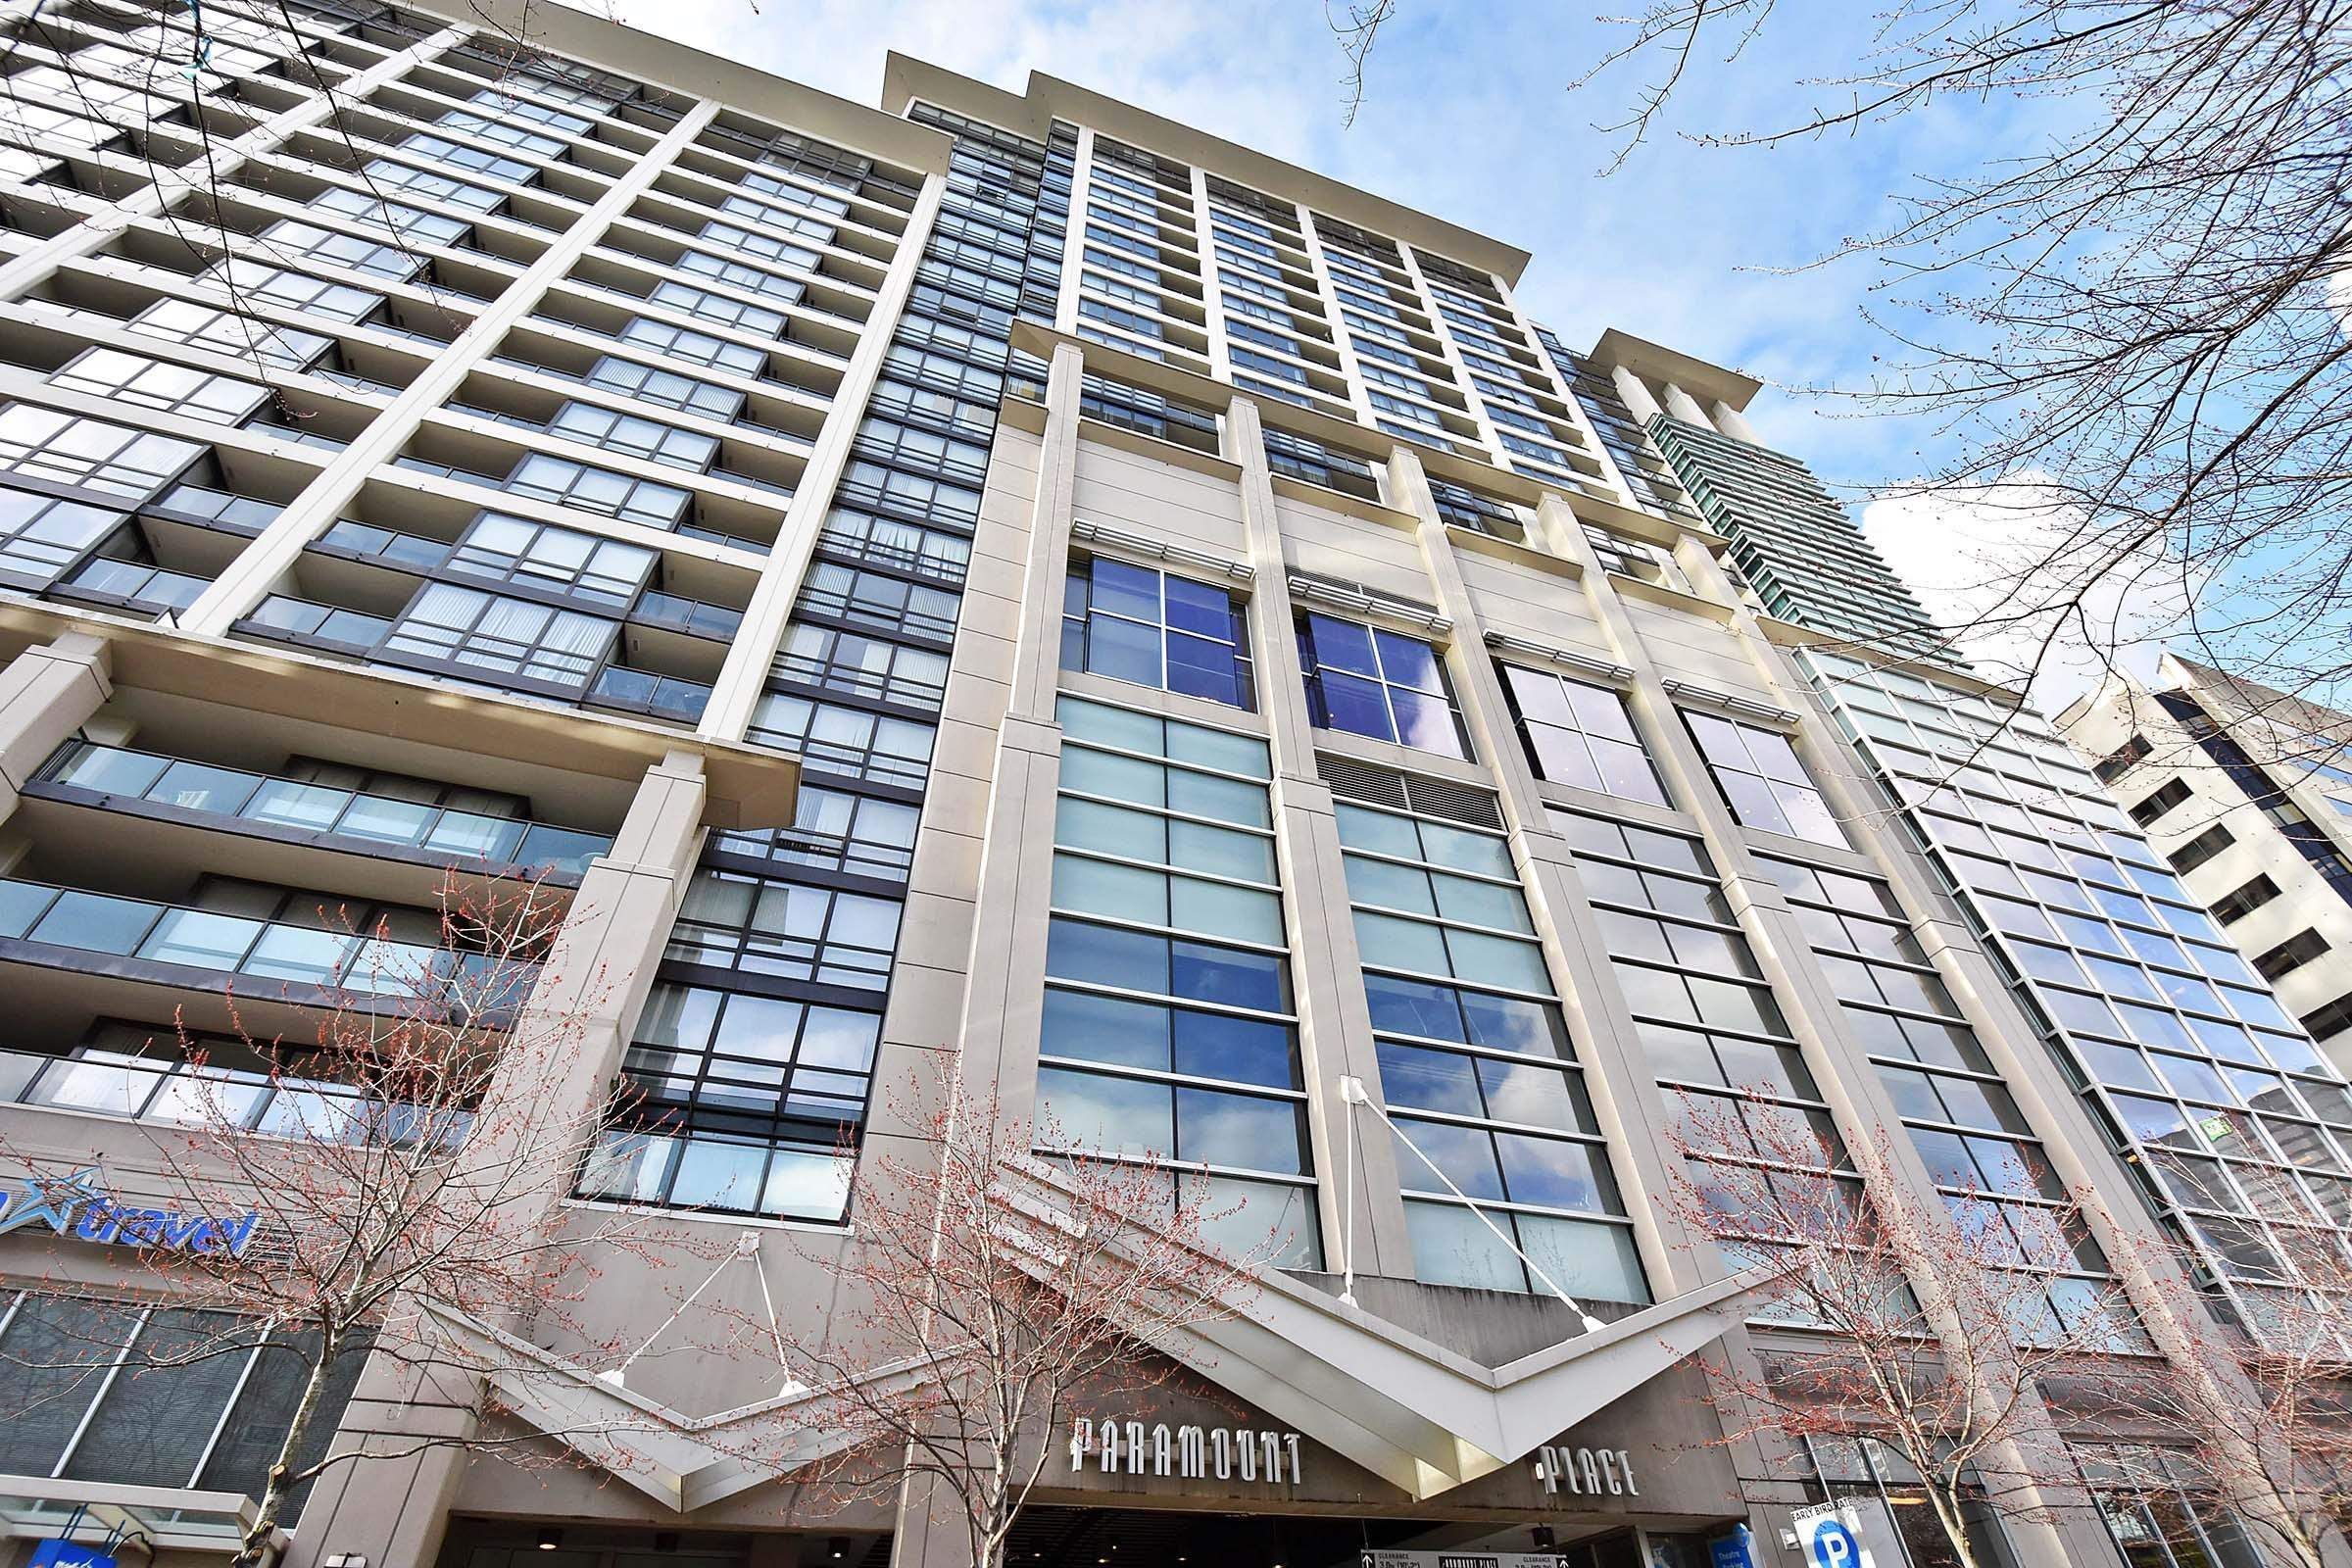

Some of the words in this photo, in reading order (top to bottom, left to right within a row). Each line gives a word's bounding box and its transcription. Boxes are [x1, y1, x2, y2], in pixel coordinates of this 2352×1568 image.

[75, 1197, 263, 1259] travel
[1070, 1418, 1301, 1485] PARAMOUNT
[1535, 1446, 1640, 1496] PLACE
[1791, 1509, 1814, 1522] EARLY
[1814, 1502, 1834, 1516] BIRD
[1833, 1496, 1853, 1510] RATE
[1822, 1531, 1849, 1568] P
